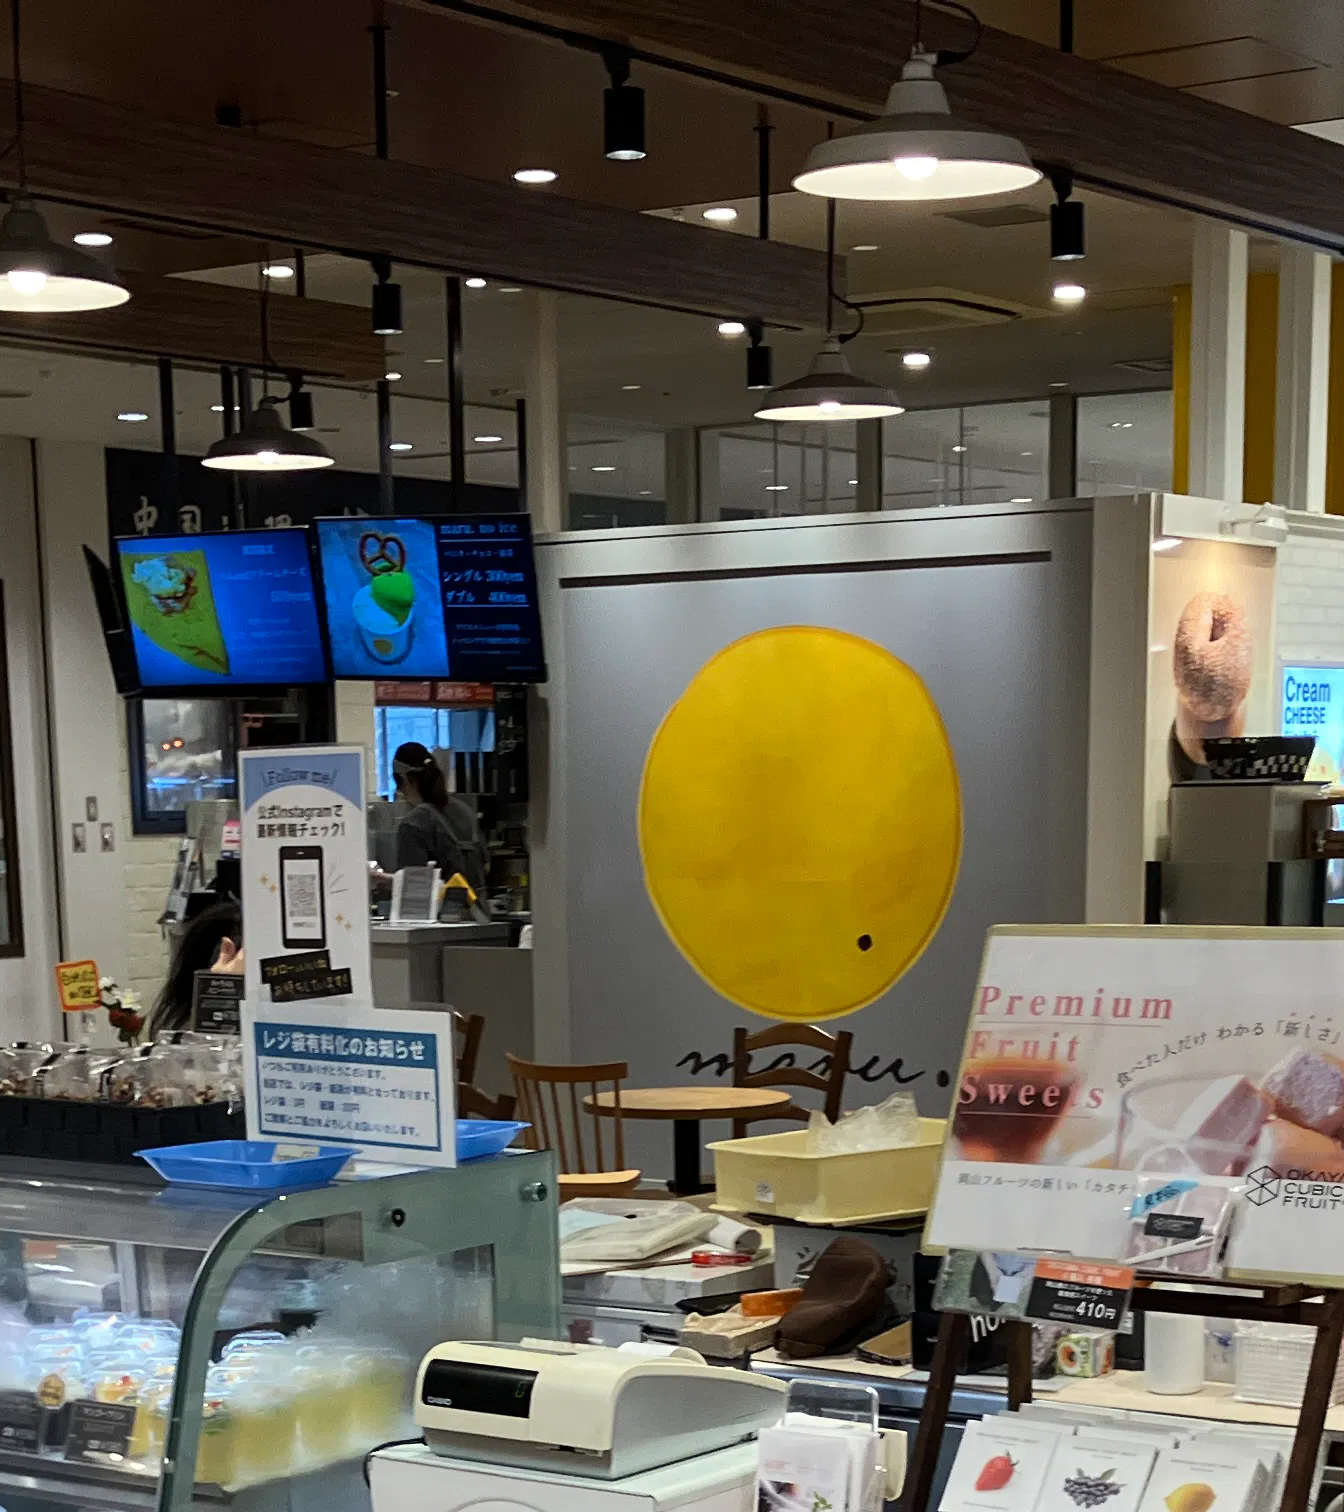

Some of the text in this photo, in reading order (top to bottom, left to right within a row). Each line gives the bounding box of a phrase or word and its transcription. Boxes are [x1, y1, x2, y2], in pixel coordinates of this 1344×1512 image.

[1285, 675, 1332, 702] Cream
[1285, 706, 1326, 724] CHEESE
[976, 986, 1173, 1020] Premium
[263, 1030, 425, 1061] レジ袋有料化のお知らせ
[968, 1031, 1081, 1062] Fruit
[960, 1075, 1105, 1109] Sweets
[1283, 1182, 1344, 1198] CUBIC
[1076, 1301, 1117, 1320] 410円
